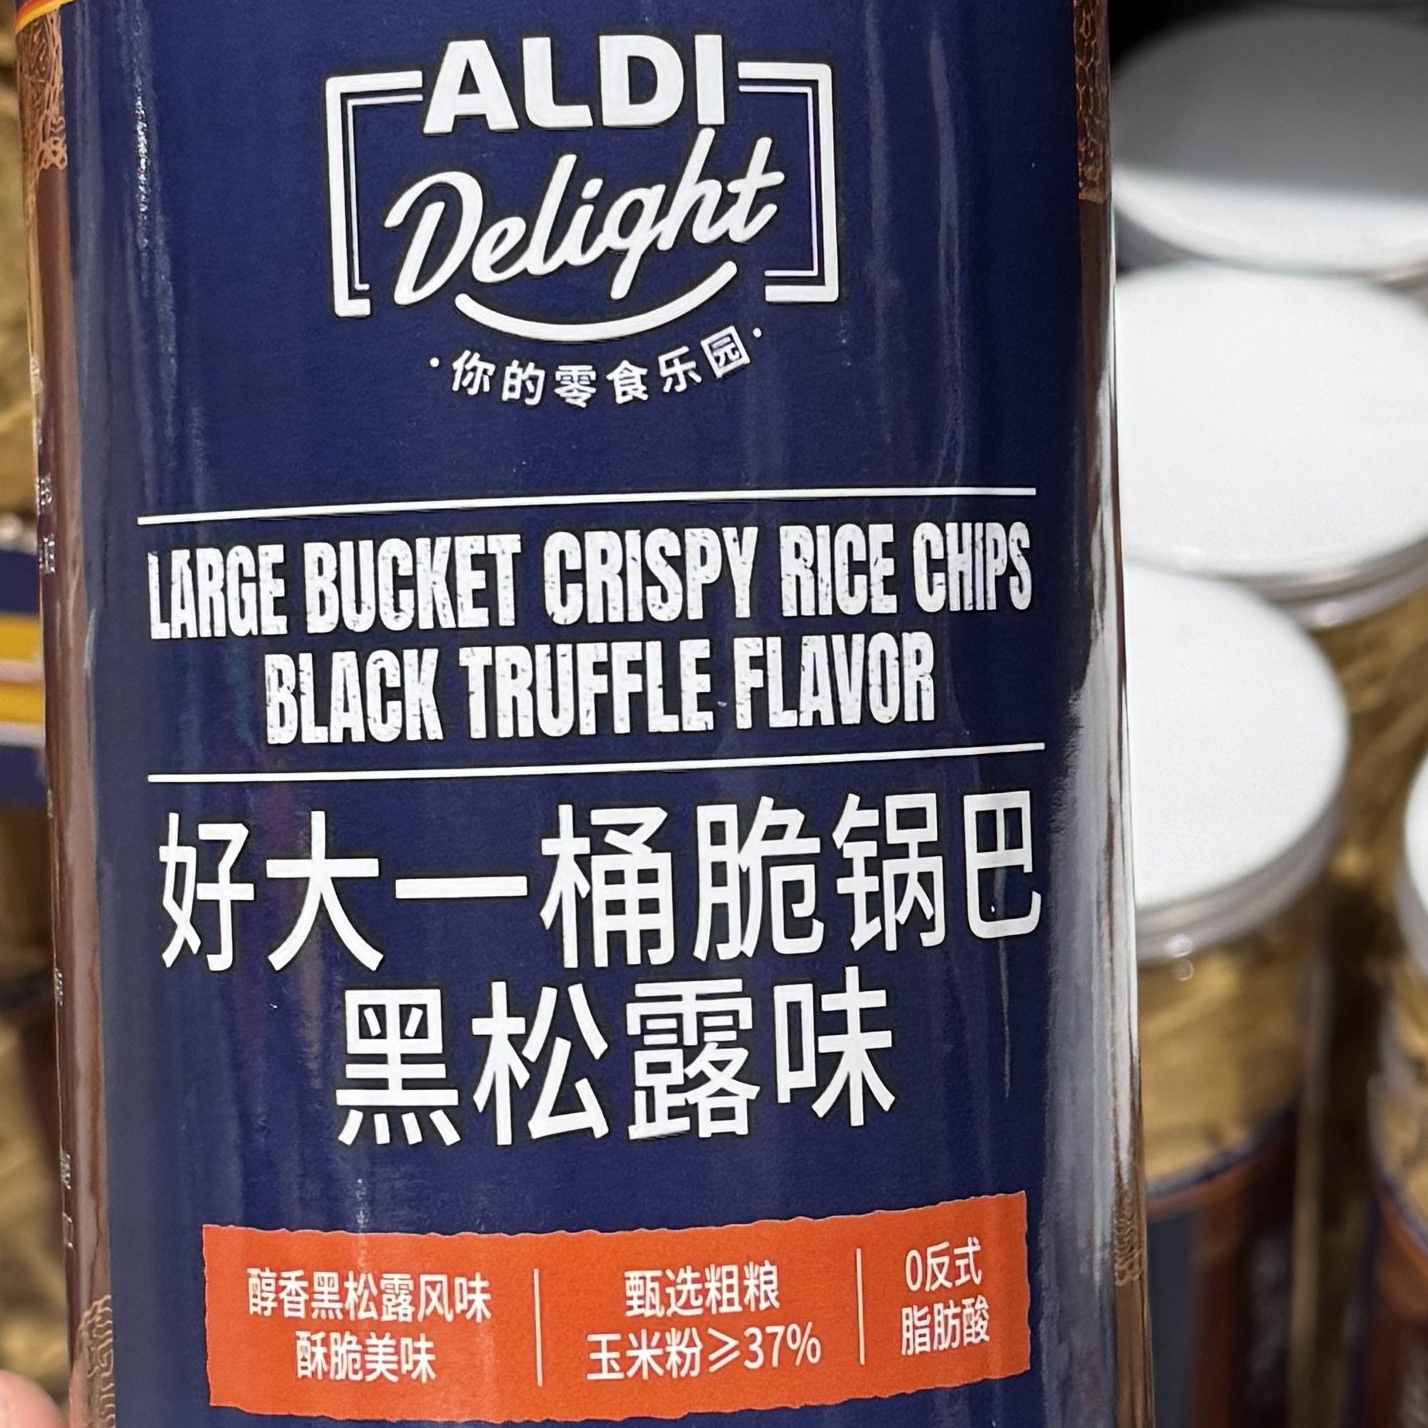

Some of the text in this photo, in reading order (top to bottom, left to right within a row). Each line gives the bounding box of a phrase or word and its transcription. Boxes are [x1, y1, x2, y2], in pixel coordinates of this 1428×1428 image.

[422, 33, 725, 134] ALDI
[384, 129, 784, 304] Delight
[148, 521, 1033, 639] LARGE BUCKET CRISPY RICE CHIPS
[265, 632, 936, 744] BLACK TRUFFLE FLAVOR
[158, 790, 1042, 971] 好大一桶脆锅巴
[336, 966, 896, 1147] 黑松露味
[247, 1267, 492, 1323] 醇香黑松露风味
[624, 1260, 780, 1318] 甄选粗粮
[905, 1237, 982, 1292] 0反式
[295, 1330, 436, 1384] 酥脆美味
[901, 1295, 990, 1355] 脂肪酸
